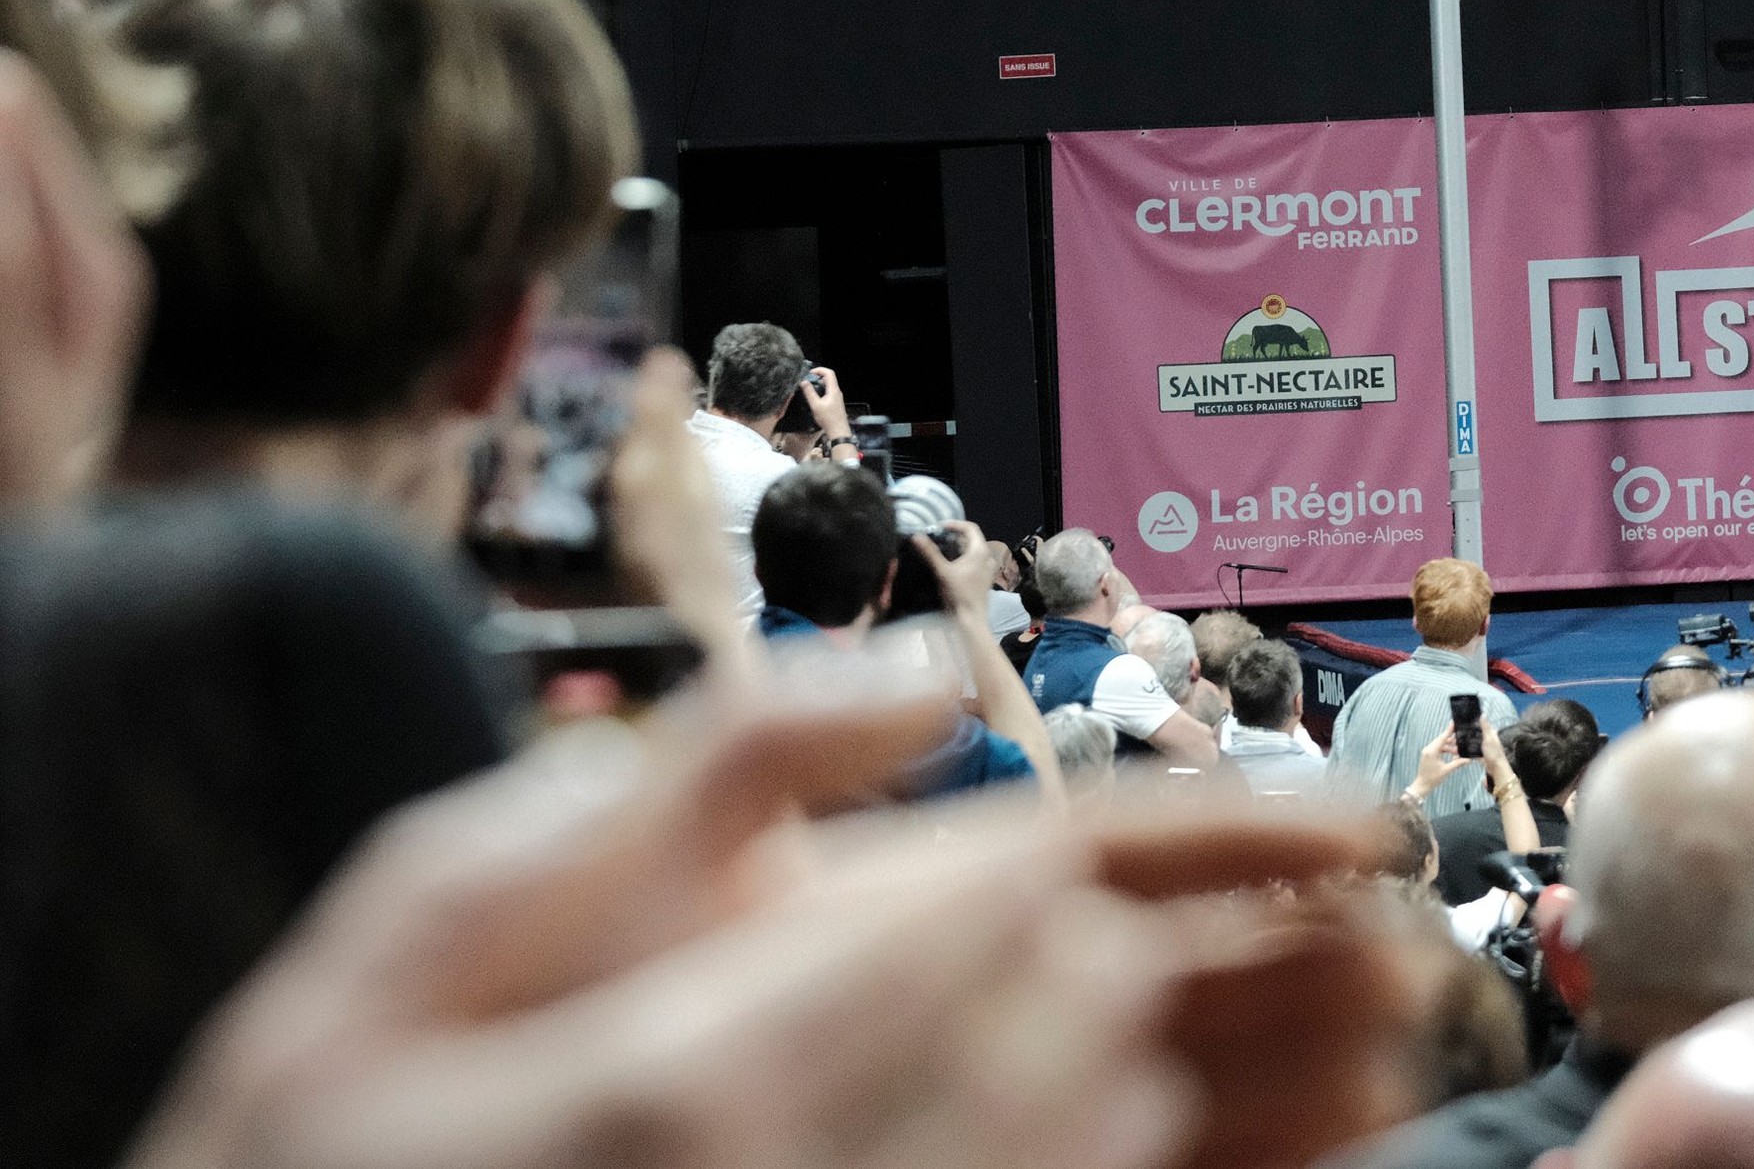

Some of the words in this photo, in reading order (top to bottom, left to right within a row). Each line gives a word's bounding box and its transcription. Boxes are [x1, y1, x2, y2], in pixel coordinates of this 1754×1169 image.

[1004, 63, 1026, 72] SANS
[1027, 61, 1050, 70] ISSUE
[1169, 178, 1221, 191] VILLE
[1235, 177, 1258, 190] DE
[1573, 267, 1692, 383] ALL
[1169, 366, 1385, 399] SAINT-NECTAIRE
[1198, 402, 1234, 414] NECTAR
[1237, 402, 1254, 413] DES
[1256, 401, 1298, 412] PRAIRIES
[1300, 398, 1358, 410] NATURELLES
[1458, 404, 1471, 453] DIMA
[1211, 488, 1258, 524] La
[1272, 481, 1422, 526] Région
[1213, 525, 1424, 553] Auvergne-Rhône-Alpes
[1620, 522, 1657, 541] let's
[1661, 523, 1708, 544] open
[1713, 521, 1742, 537] our
[1317, 669, 1346, 706] DIMA
